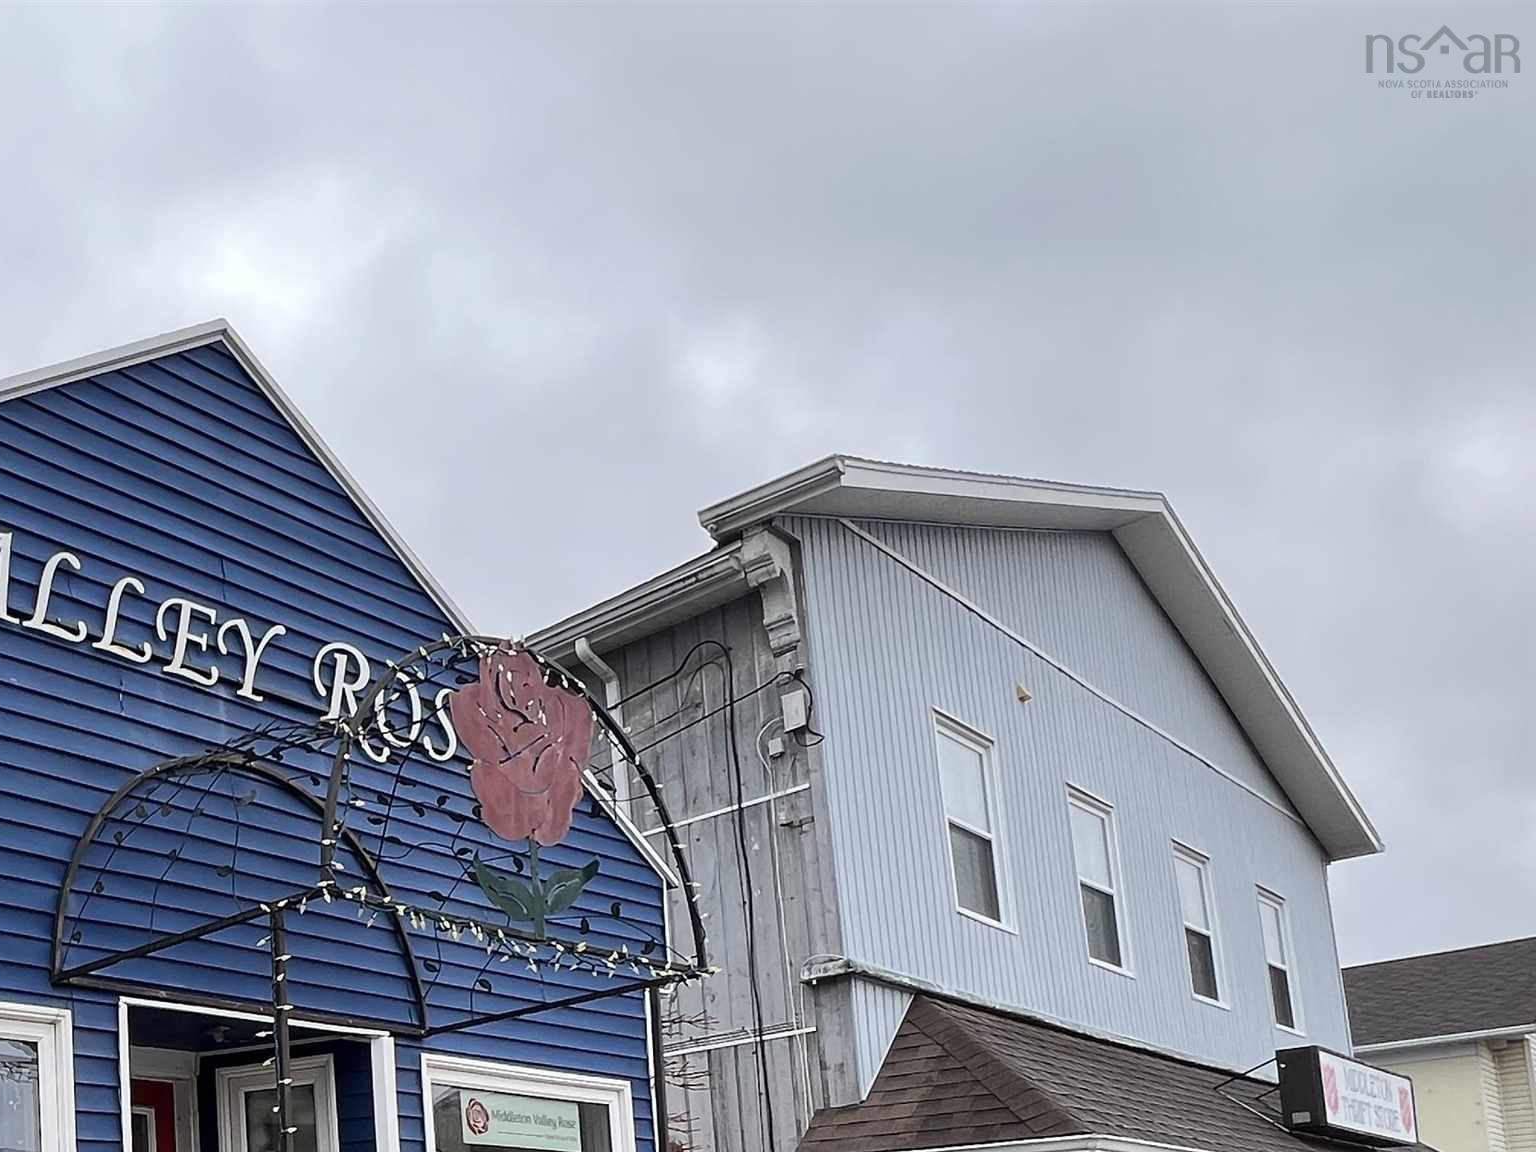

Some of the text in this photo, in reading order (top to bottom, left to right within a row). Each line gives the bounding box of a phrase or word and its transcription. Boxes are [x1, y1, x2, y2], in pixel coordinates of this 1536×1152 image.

[312, 641, 458, 764] ROS
[491, 1109, 576, 1130] Middleton Valley Rose
